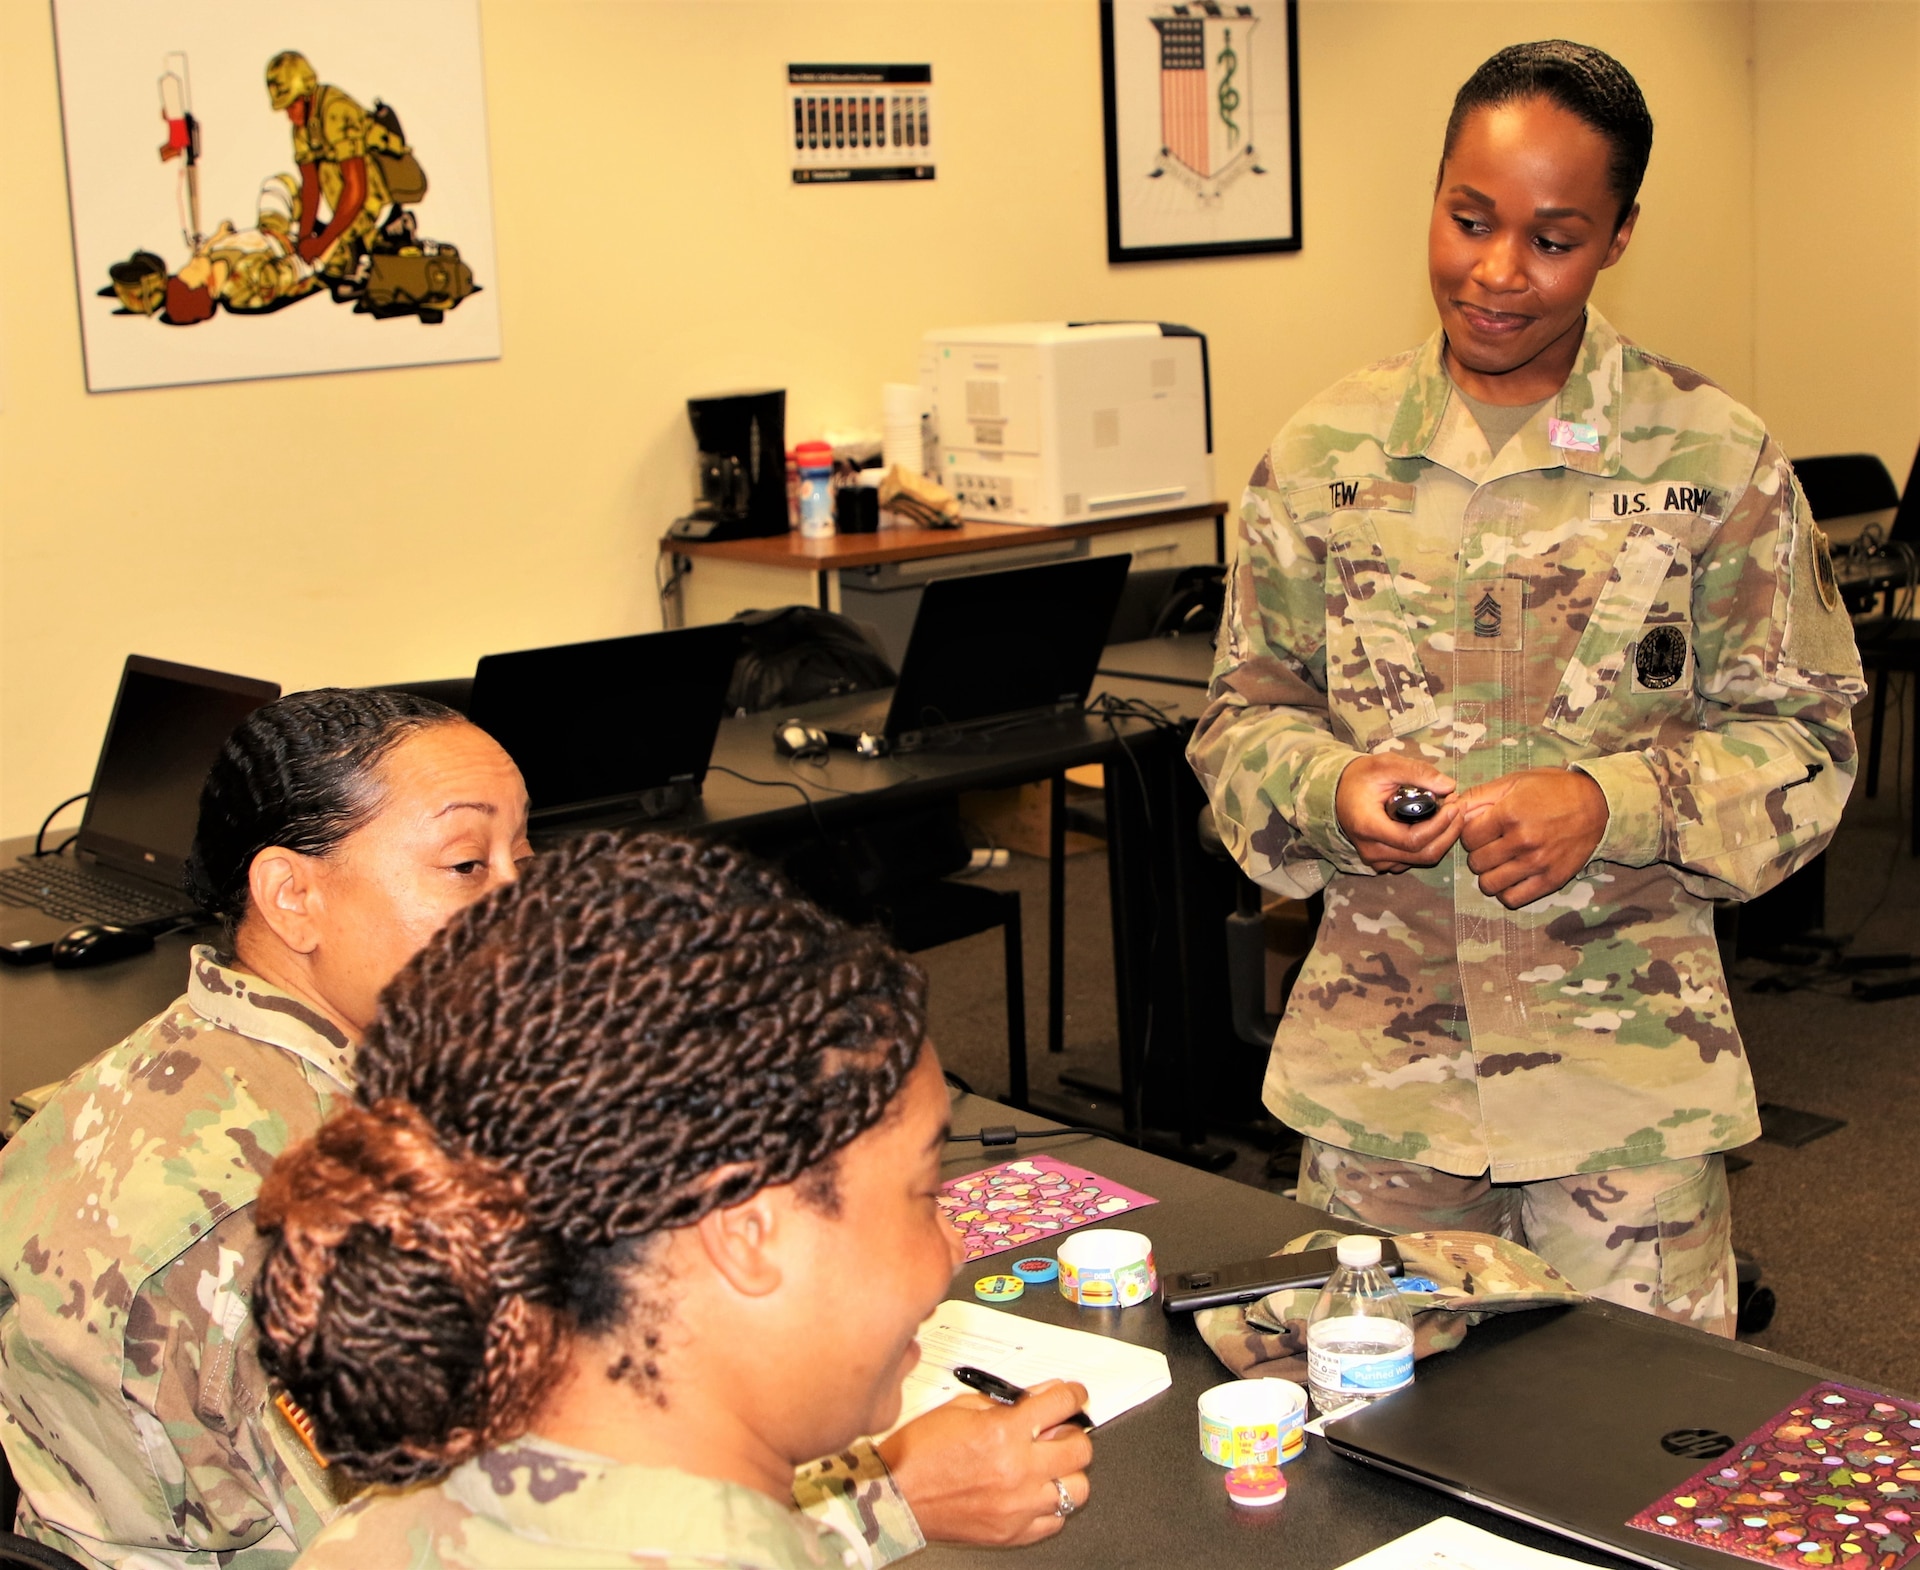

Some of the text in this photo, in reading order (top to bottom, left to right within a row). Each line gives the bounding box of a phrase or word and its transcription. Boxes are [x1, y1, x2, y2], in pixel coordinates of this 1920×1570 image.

[1329, 481, 1359, 510] TEW
[1613, 487, 1712, 516] U.S. ARMY
[1354, 1369, 1394, 1380] Purified
[1237, 1430, 1257, 1441] YOU
